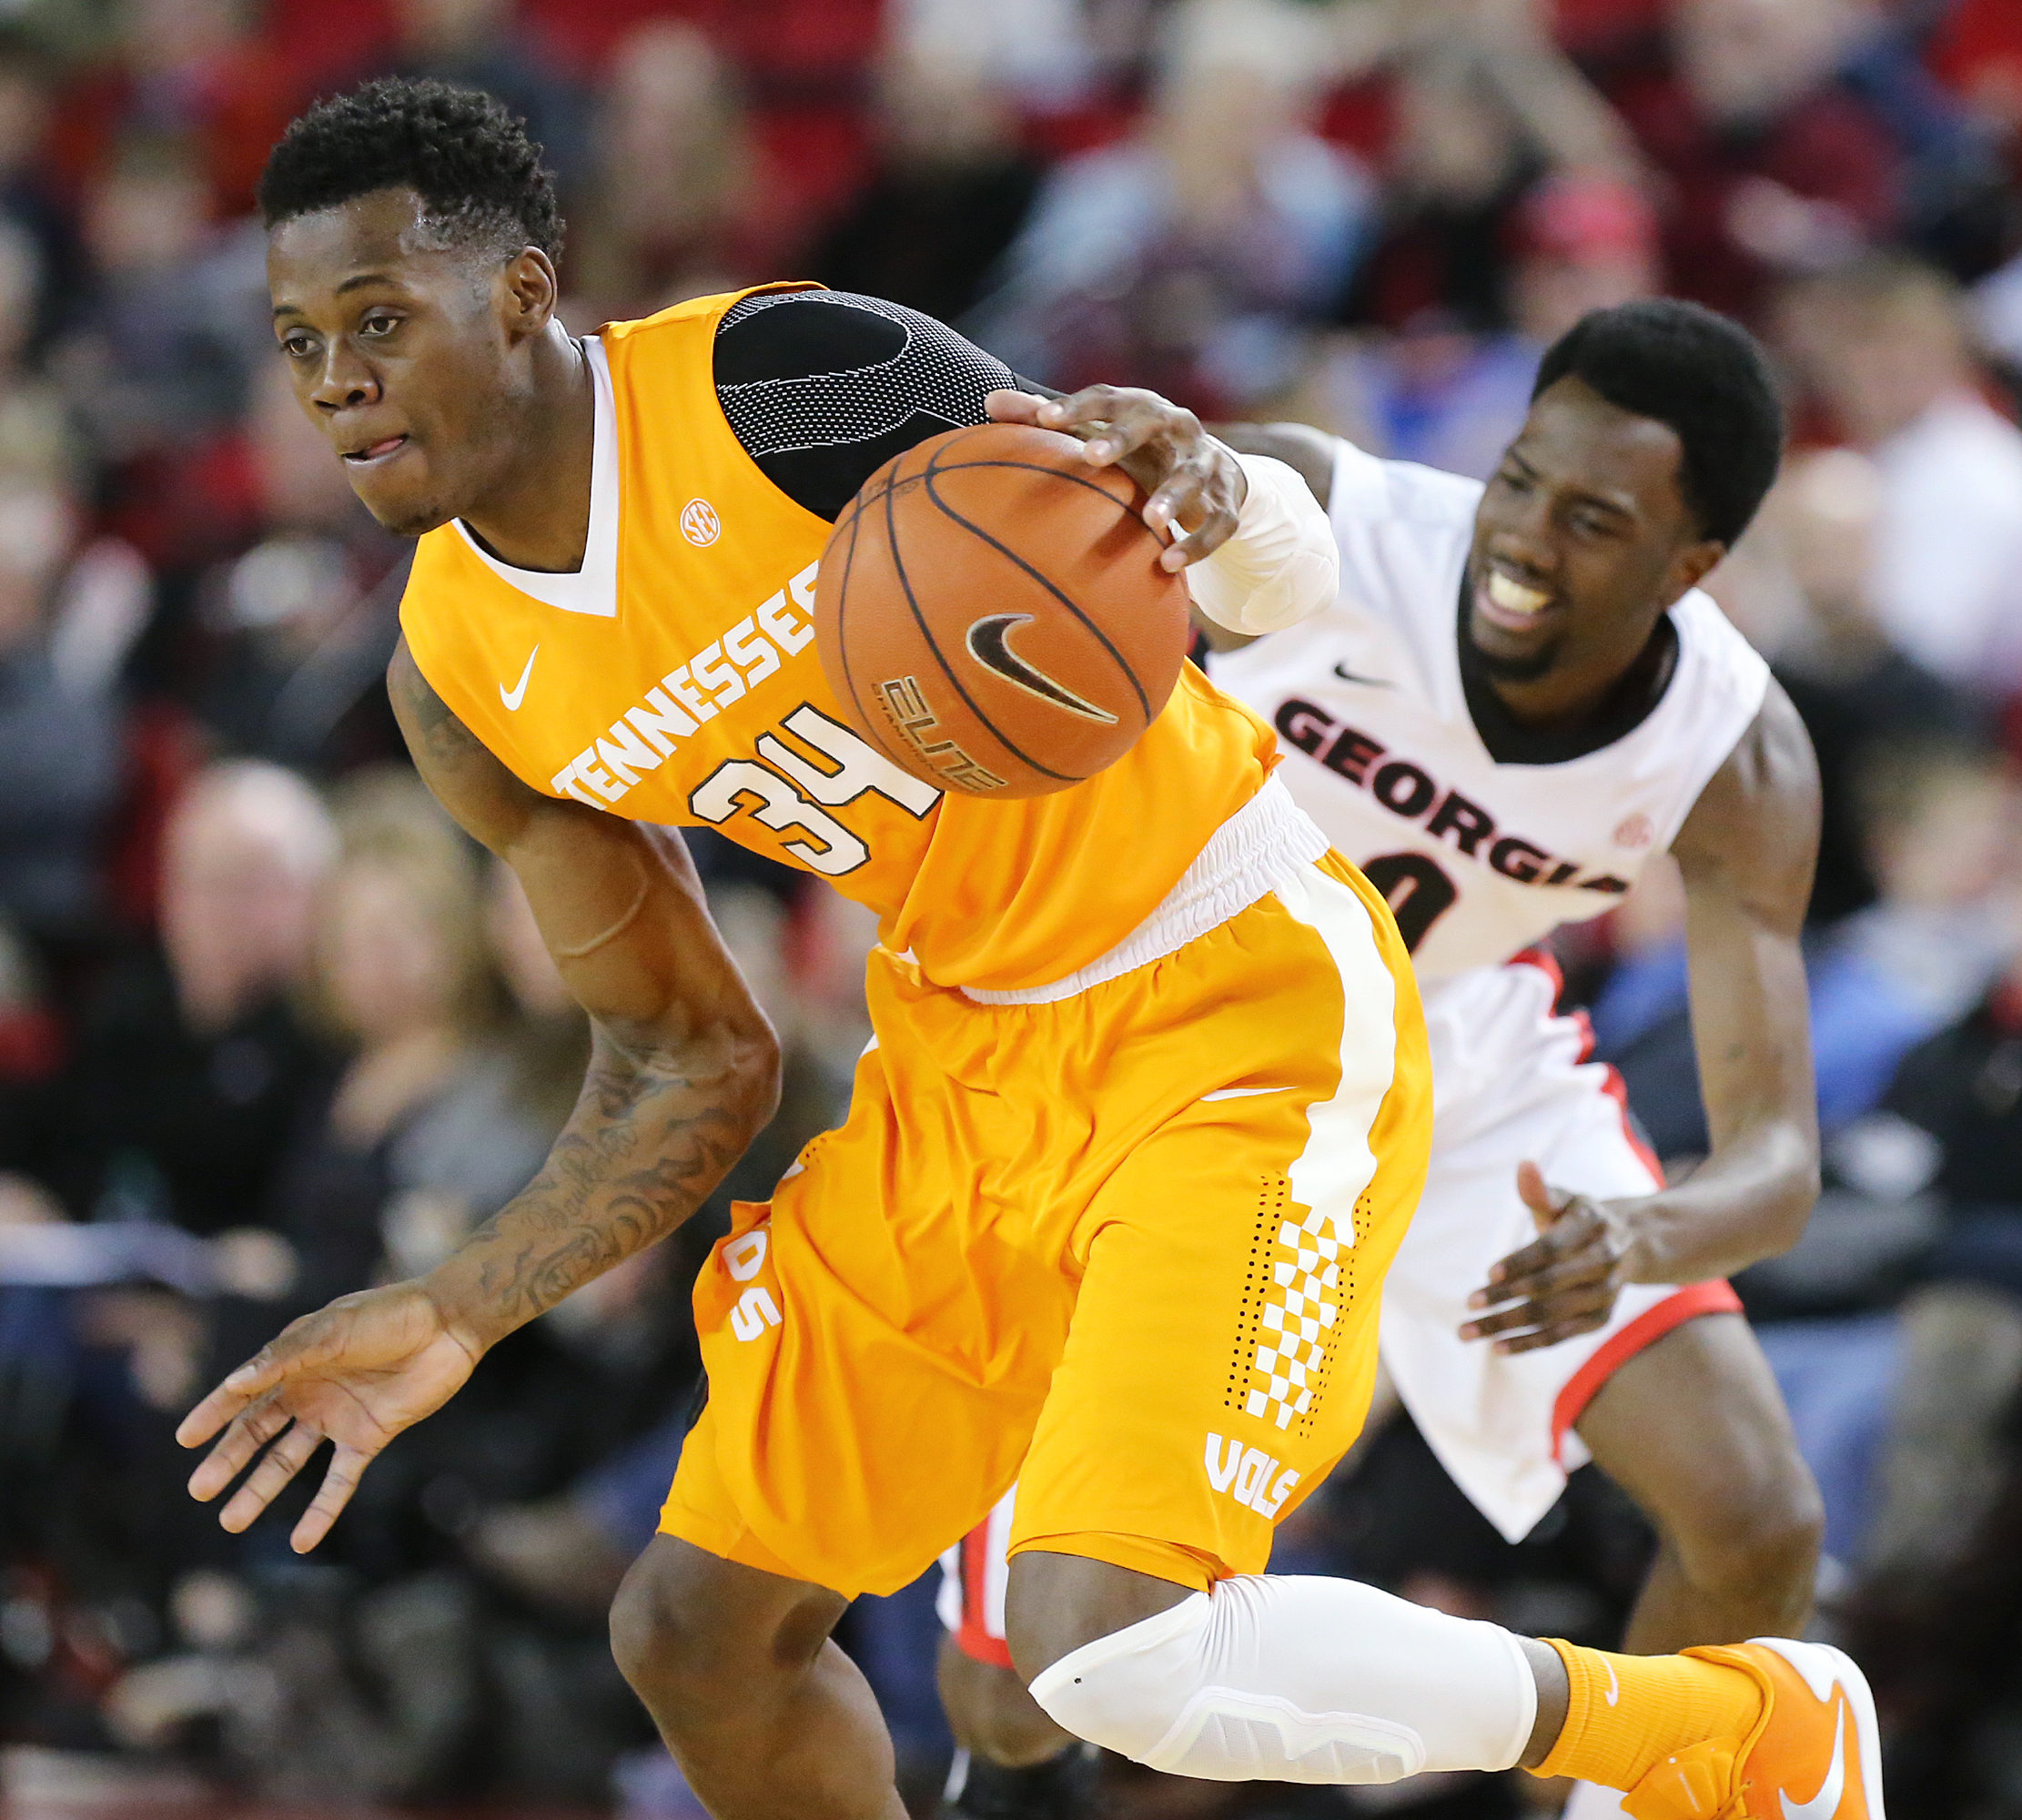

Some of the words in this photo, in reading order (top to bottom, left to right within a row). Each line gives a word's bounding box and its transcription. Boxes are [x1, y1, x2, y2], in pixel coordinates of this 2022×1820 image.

[684, 502, 716, 543] SEC
[688, 701, 945, 876] 34
[881, 675, 1010, 794] ELITE
[1275, 699, 1630, 894] GEORGIA
[1204, 1431, 1301, 1521] VOLS
